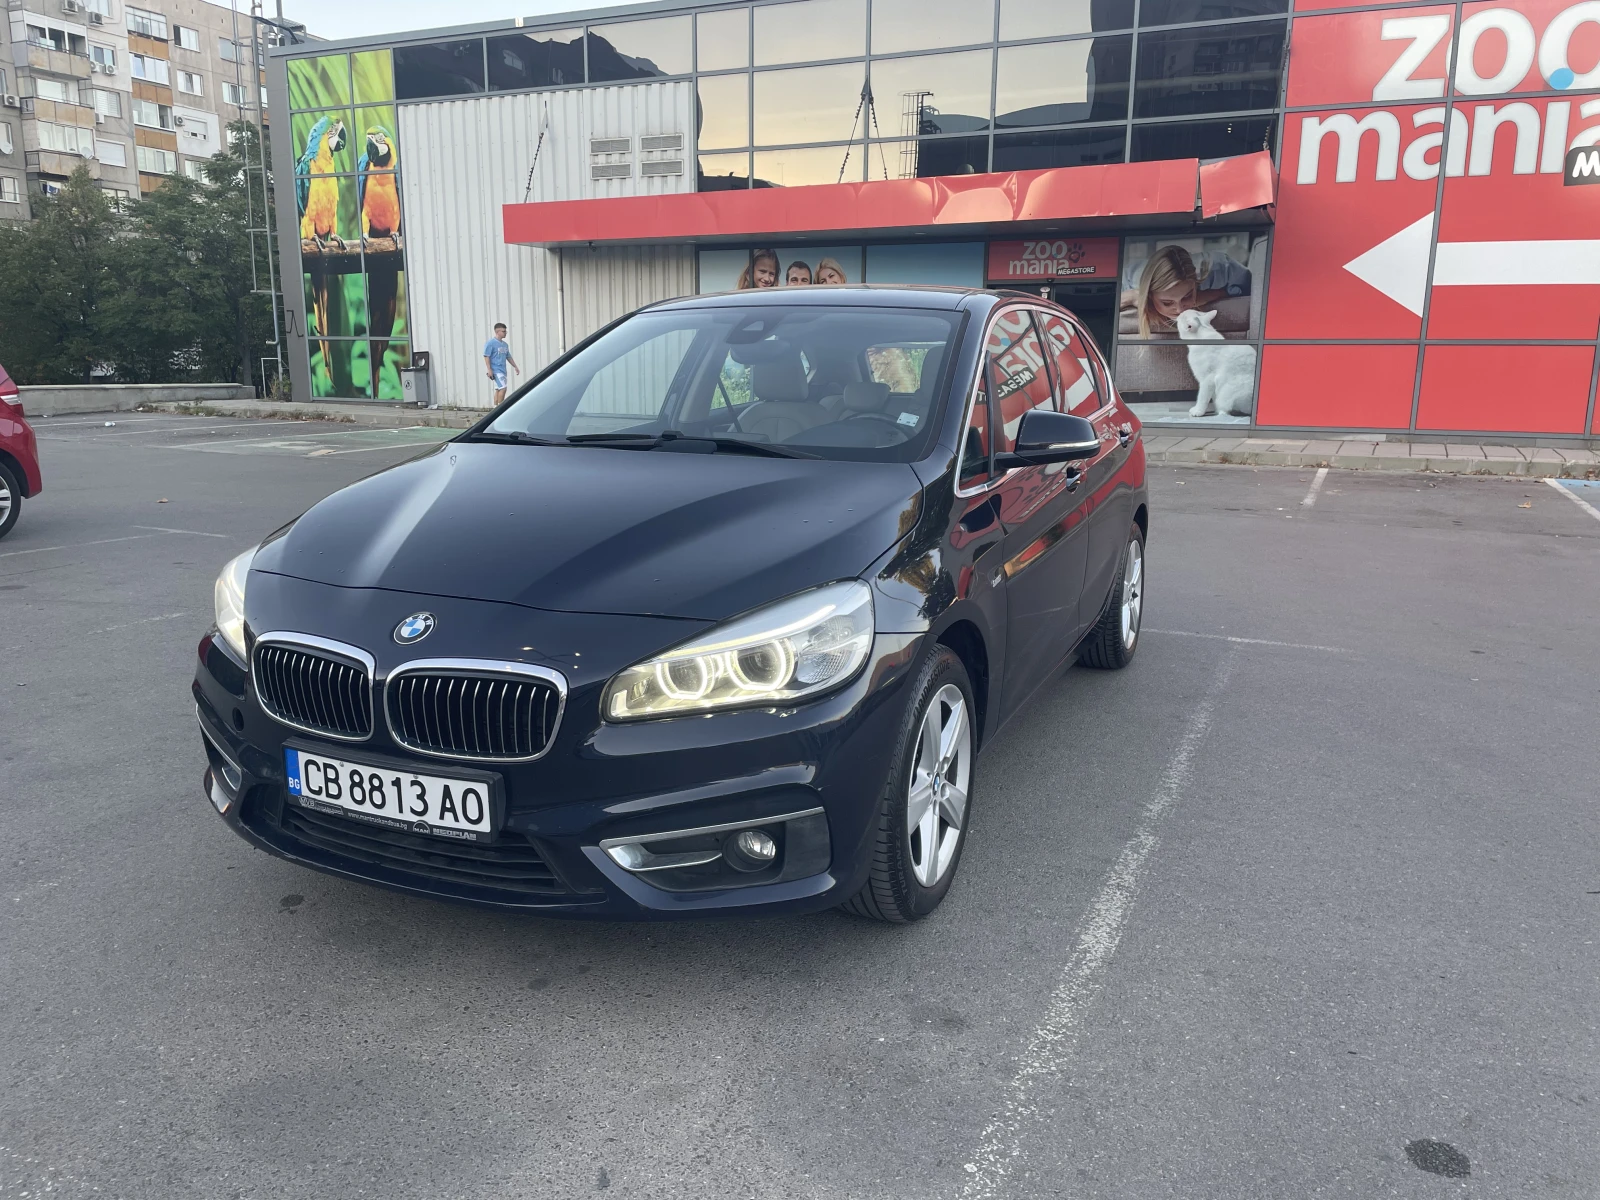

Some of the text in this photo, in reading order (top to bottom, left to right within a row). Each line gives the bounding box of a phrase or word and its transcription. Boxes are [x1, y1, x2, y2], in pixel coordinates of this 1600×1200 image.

[1008, 259, 1070, 275] mania
[1057, 266, 1095, 276] MEGASTORE
[288, 777, 300, 790] BG
[303, 758, 485, 826] CB 8813 AO
